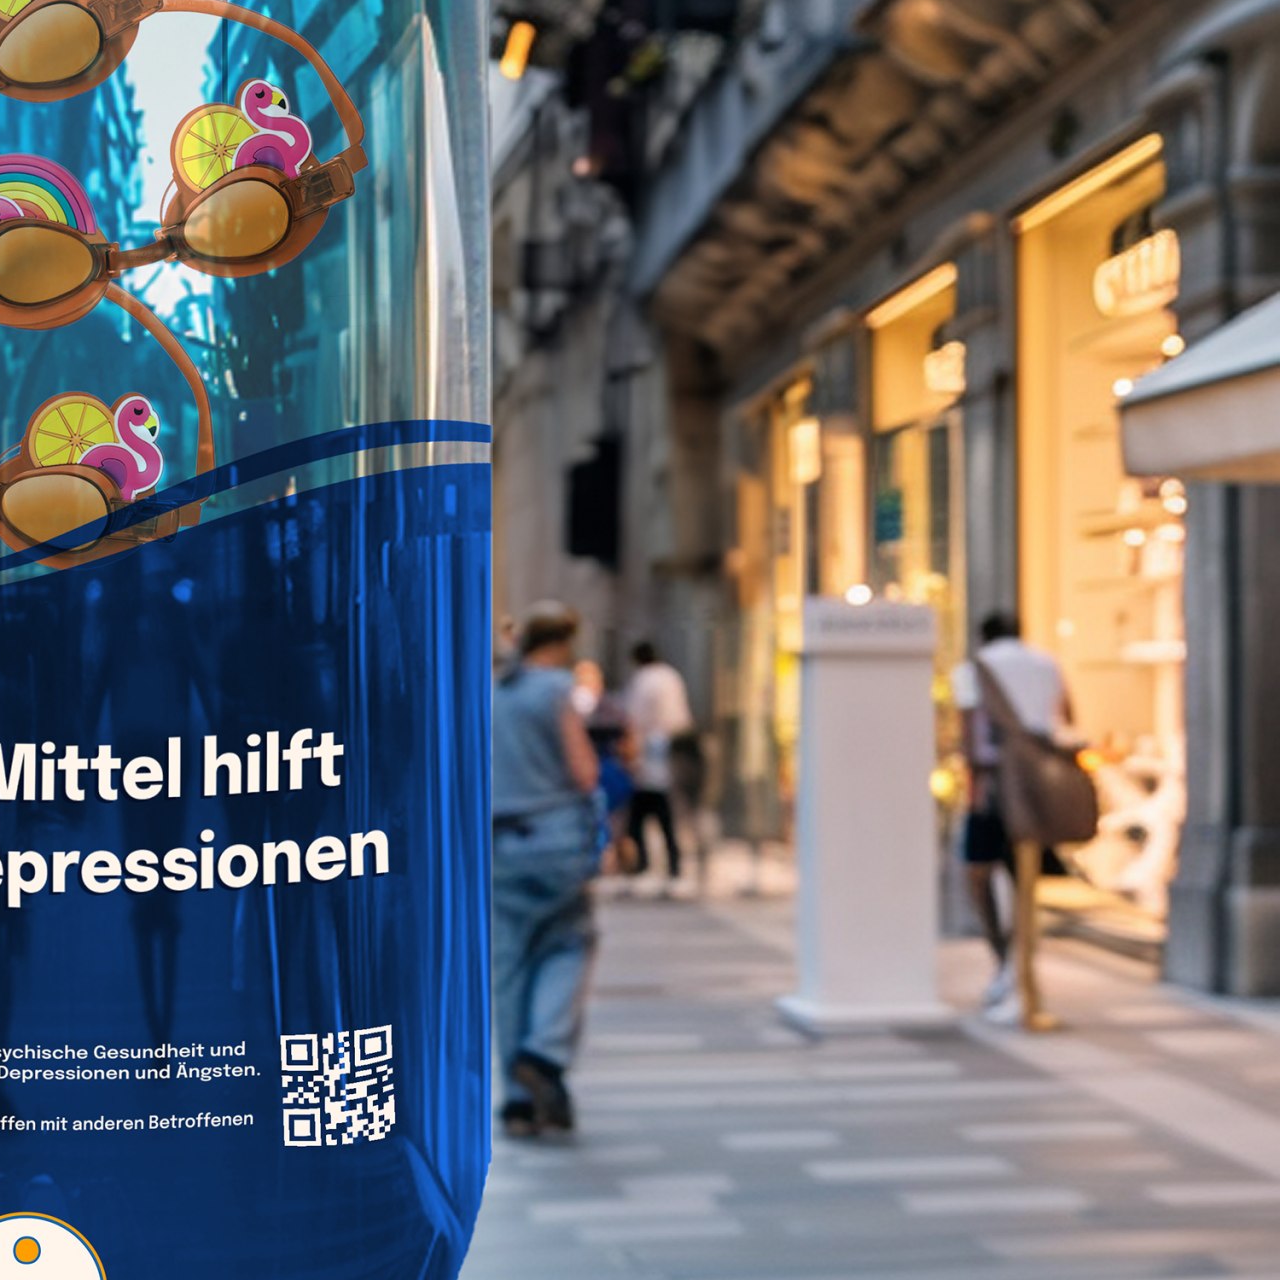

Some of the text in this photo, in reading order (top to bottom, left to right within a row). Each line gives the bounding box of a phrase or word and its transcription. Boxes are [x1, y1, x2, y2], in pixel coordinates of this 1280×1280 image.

[204, 728, 344, 796] hilft
[93, 1043, 205, 1060] Gesundheit
[210, 1040, 246, 1057] und
[135, 1064, 171, 1080] und
[176, 1061, 261, 1082] Ängsten.
[40, 1116, 68, 1131] mit
[72, 1115, 144, 1131] anderen
[148, 1111, 254, 1130] Betroffenen
